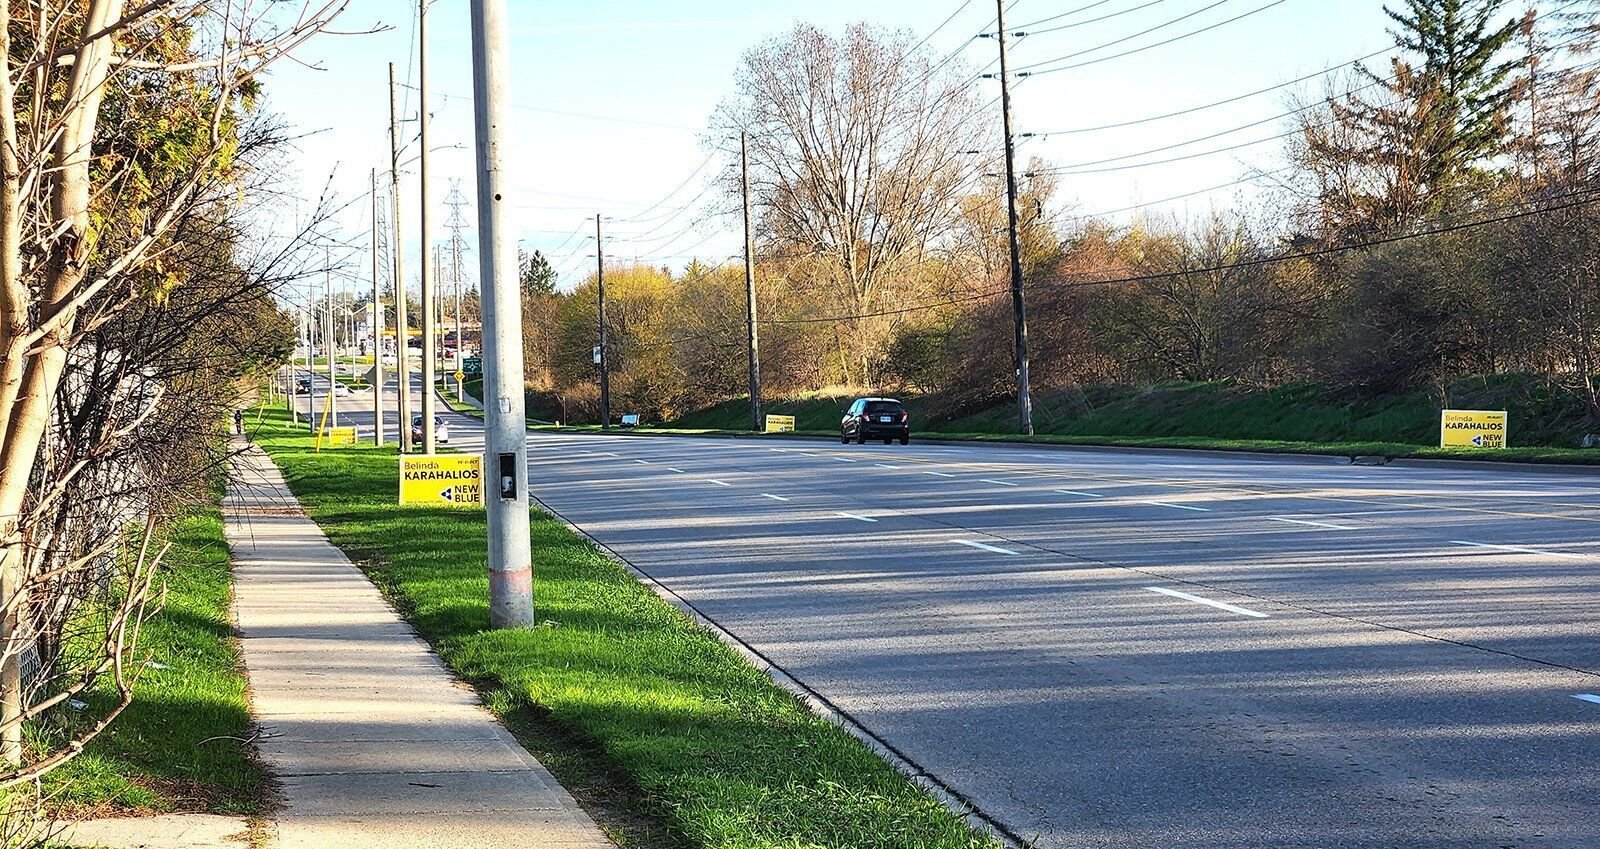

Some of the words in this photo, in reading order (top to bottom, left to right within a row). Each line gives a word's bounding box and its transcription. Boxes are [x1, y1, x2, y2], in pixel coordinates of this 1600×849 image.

[404, 461, 439, 470] Belinda
[404, 470, 479, 480] KARAHALIOS
[454, 485, 479, 493] NEW
[455, 494, 480, 503] BLUE
